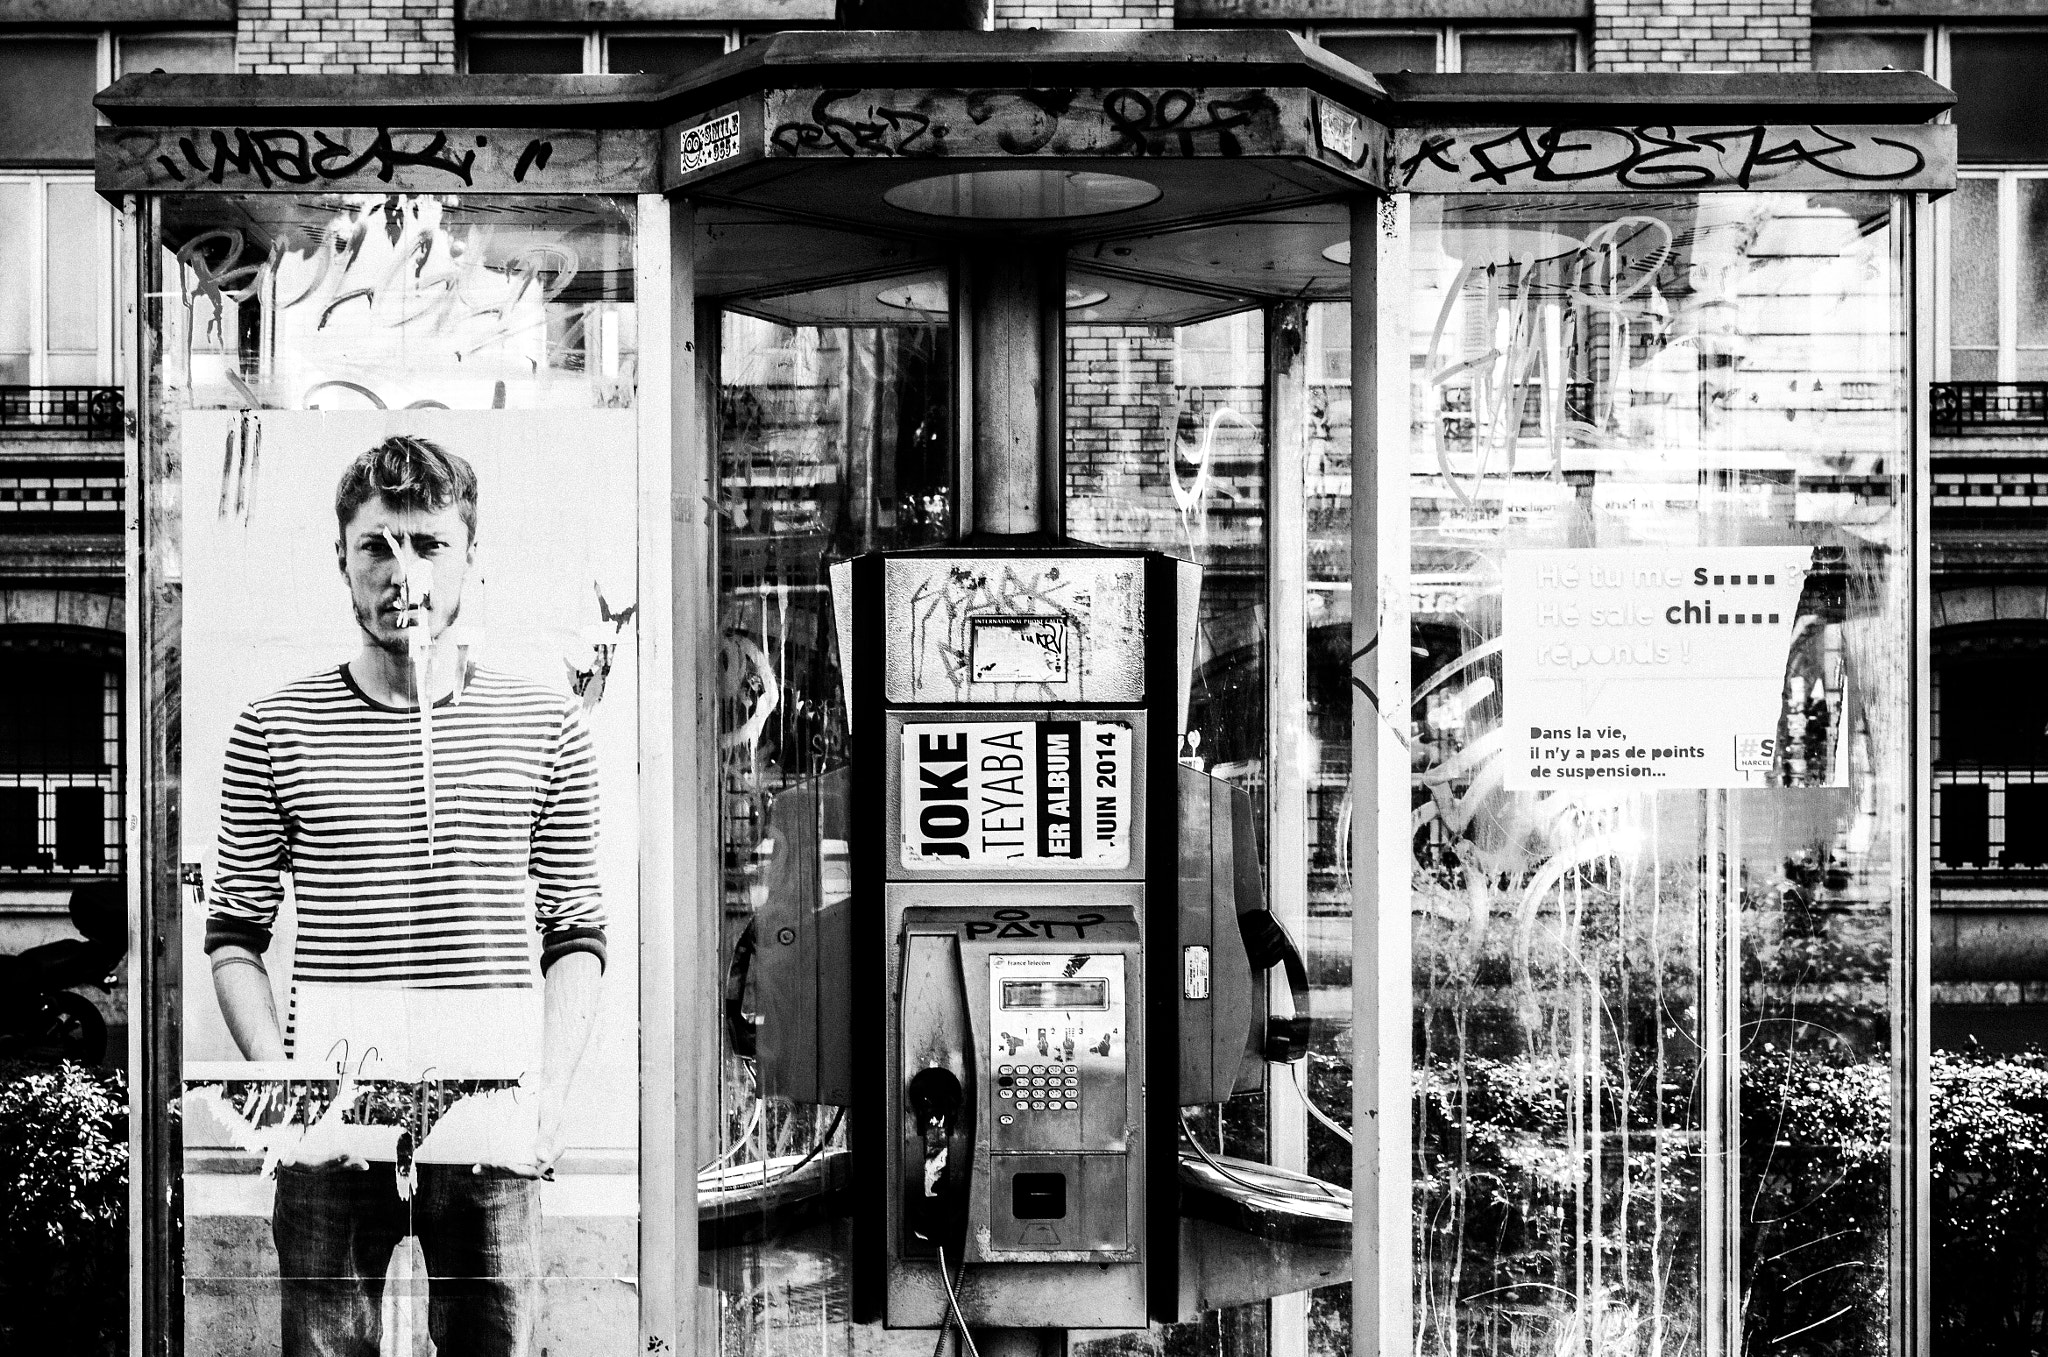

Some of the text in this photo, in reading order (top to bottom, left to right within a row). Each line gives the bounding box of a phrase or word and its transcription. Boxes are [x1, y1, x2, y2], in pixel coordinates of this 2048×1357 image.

[704, 114, 738, 146] SMILE
[1535, 563, 1579, 590] Hé
[1589, 565, 1623, 589] tu
[1633, 567, 1683, 589] me
[1535, 601, 1579, 627] Hé
[1591, 600, 1655, 627] sale
[1536, 638, 1671, 671] réponds
[1529, 726, 1627, 742] Dans la vie,
[1096, 732, 1117, 789] 2014
[1529, 746, 1706, 762] il n'y a pas de points
[1741, 759, 1772, 767] MARCEL
[1046, 733, 1070, 818] ALBUM
[1529, 765, 1667, 781] de suspension...
[919, 732, 970, 859] JOKE
[980, 730, 1025, 860] TEYABA
[1096, 796, 1117, 847] JUIN
